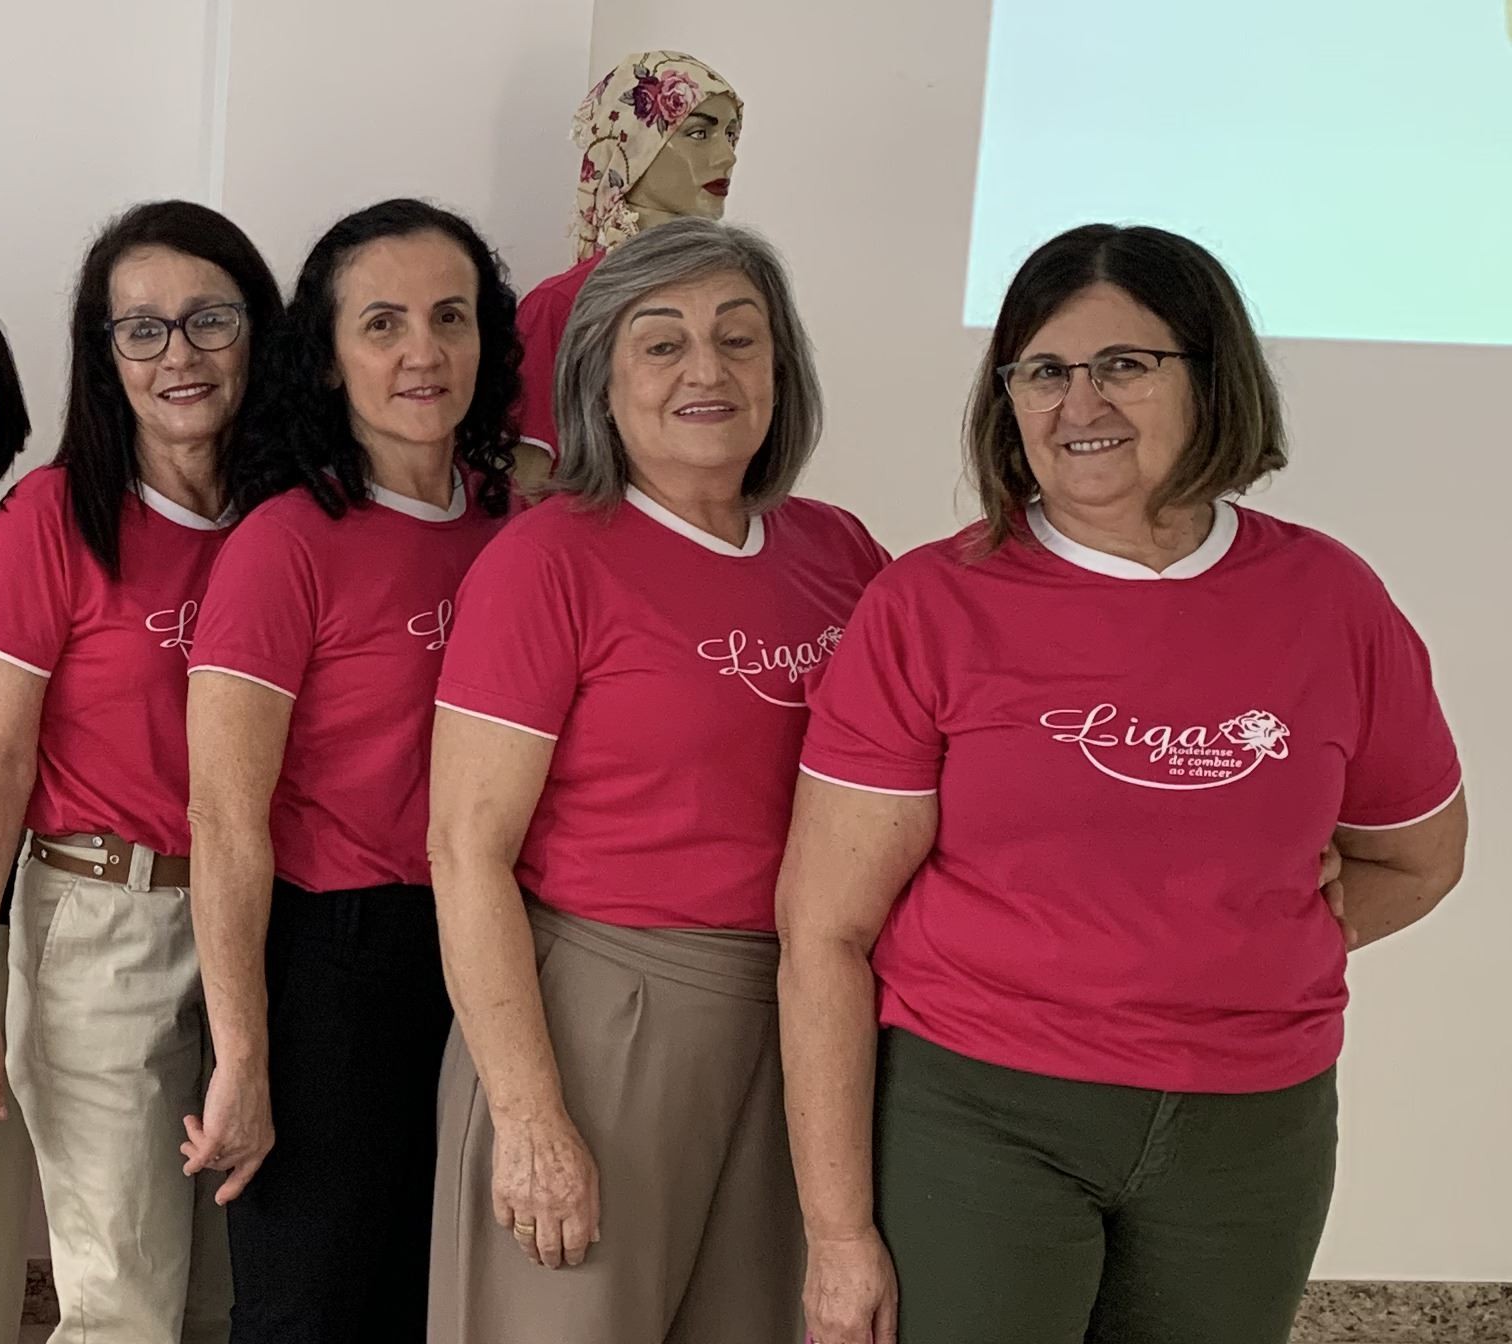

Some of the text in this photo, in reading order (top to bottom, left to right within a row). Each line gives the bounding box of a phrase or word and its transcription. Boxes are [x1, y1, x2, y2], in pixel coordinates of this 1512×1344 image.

[697, 629, 822, 683] Liga
[1039, 703, 1222, 763] Liga
[1168, 746, 1234, 757] Rodeiense
[1168, 755, 1243, 768] de combate
[1168, 766, 1233, 778] ao câncer
